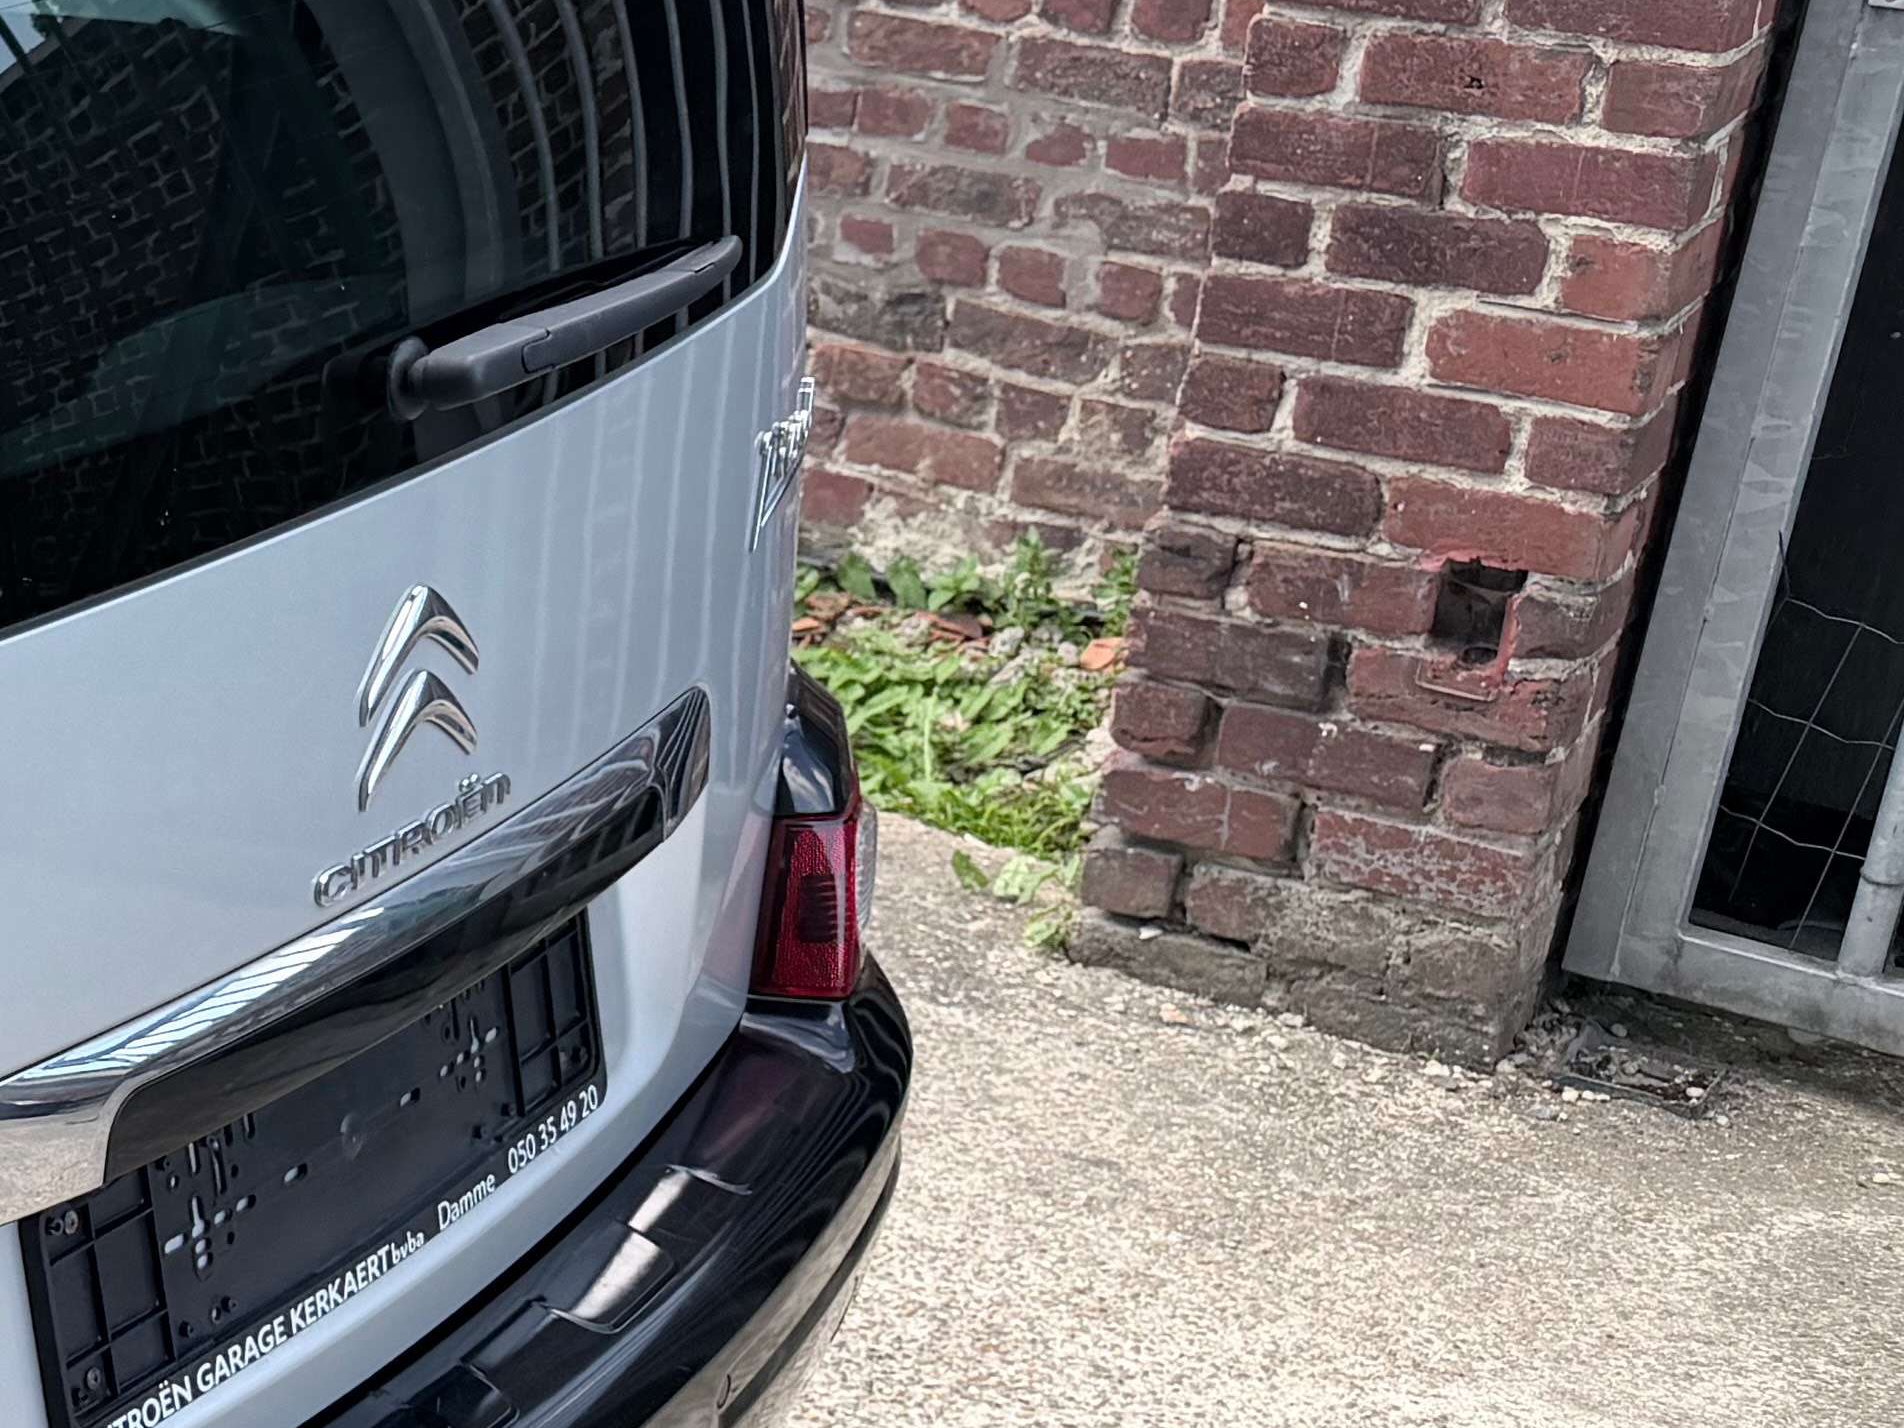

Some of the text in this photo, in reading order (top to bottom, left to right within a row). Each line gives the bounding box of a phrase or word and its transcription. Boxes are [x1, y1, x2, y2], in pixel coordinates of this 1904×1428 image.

[196, 1315, 288, 1393] GARAGE
[437, 1174, 496, 1231] Damme
[507, 1132, 536, 1174] 050
[538, 1115, 557, 1151] 35
[560, 1099, 577, 1133] 49
[579, 1083, 598, 1118] 20
